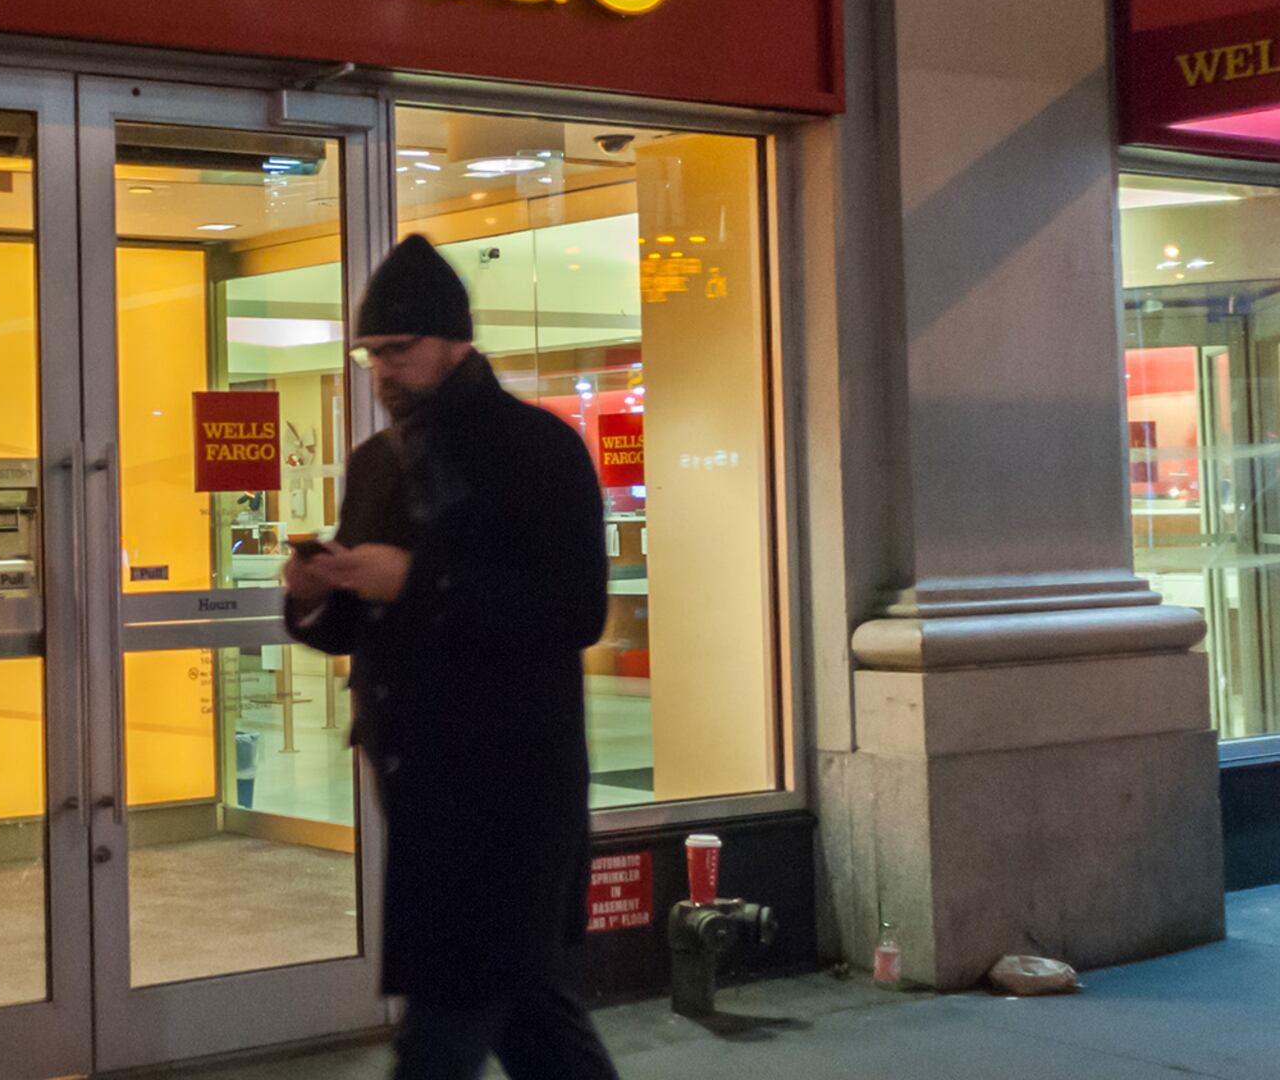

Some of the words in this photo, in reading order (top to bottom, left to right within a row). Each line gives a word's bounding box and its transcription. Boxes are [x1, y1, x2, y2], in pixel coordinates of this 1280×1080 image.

[202, 422, 276, 439] WELLS
[602, 435, 644, 449] WELLS
[205, 443, 276, 461] FARGO
[1, 573, 25, 586] Pull
[198, 598, 238, 612] Hours
[591, 855, 641, 871] AUTOMATIC
[591, 869, 640, 886] SPRINKLER
[611, 886, 621, 898] IN
[592, 899, 639, 915] BASEMENT
